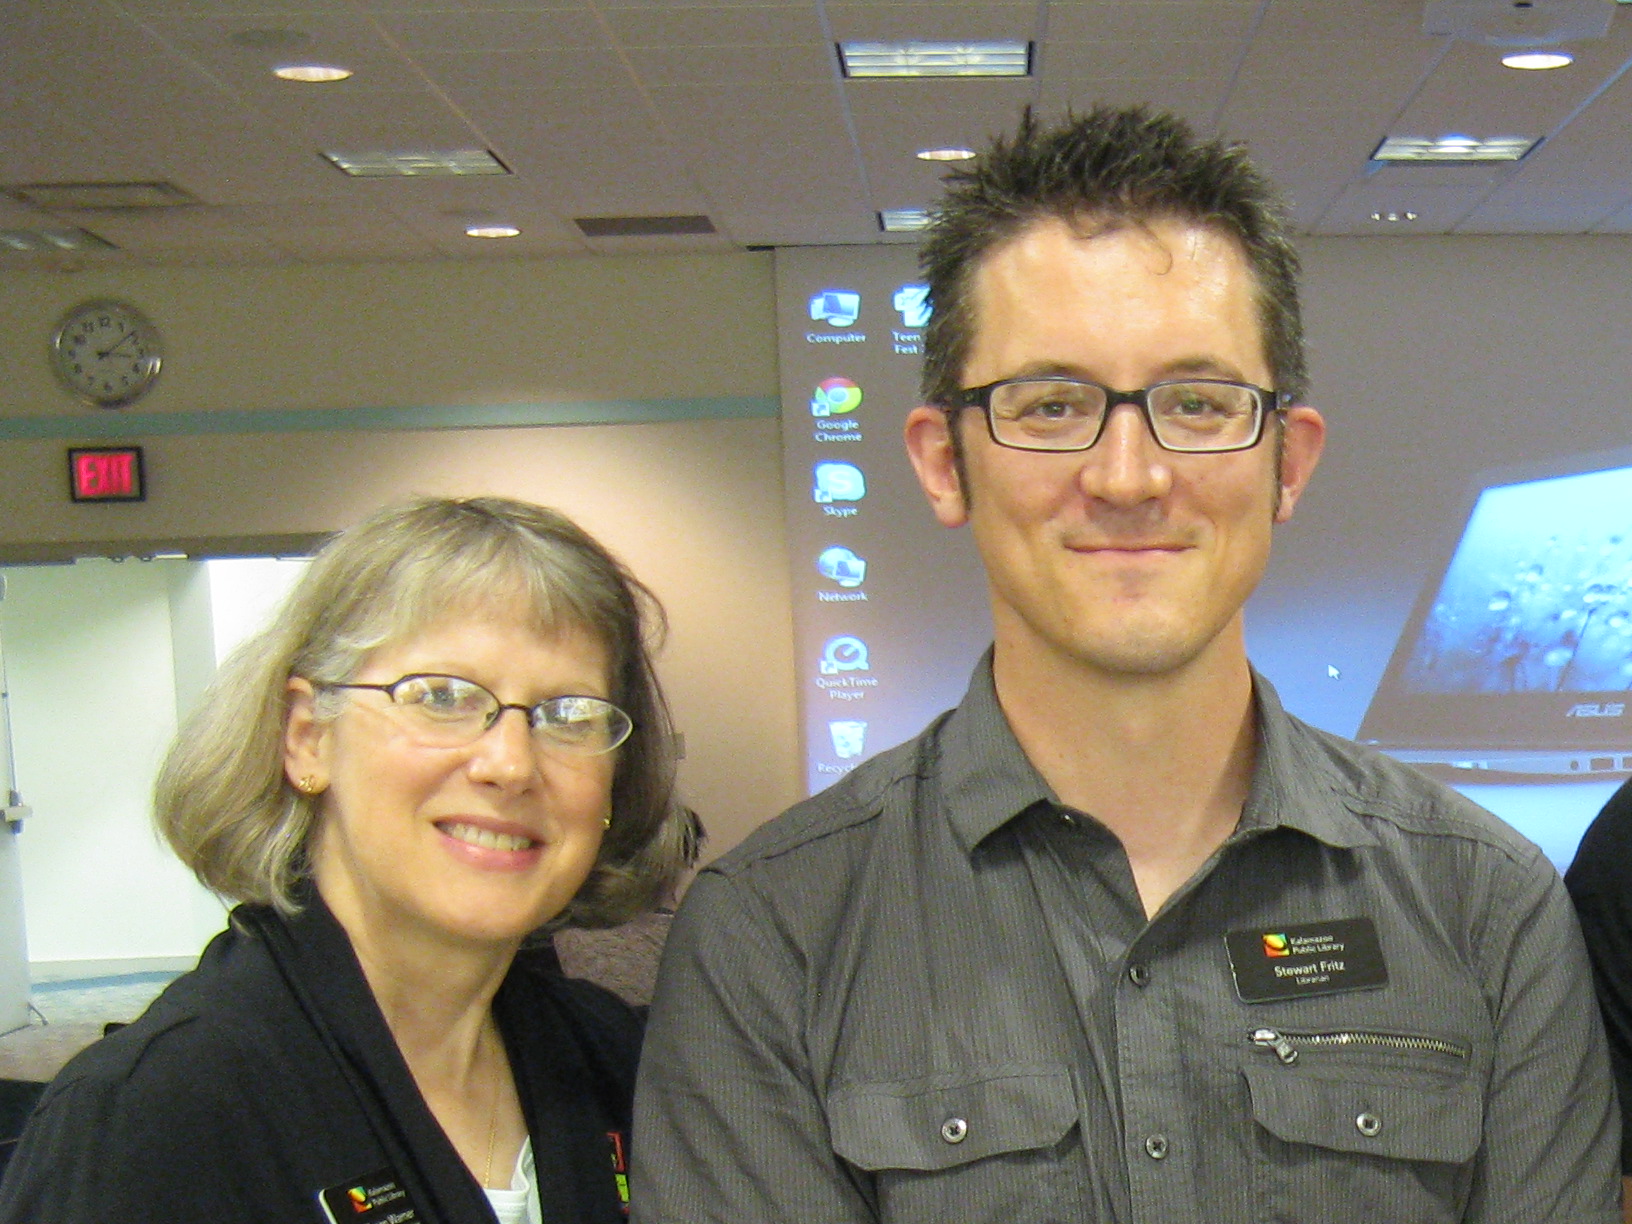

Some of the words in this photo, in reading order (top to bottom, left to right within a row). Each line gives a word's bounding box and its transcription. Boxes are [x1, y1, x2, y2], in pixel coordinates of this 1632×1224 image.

[806, 332, 866, 344] Computer
[816, 420, 859, 431] Google
[814, 431, 862, 442] Chrome
[77, 453, 134, 495] EXIT
[823, 505, 858, 518] Skype
[818, 591, 868, 602] Network
[815, 677, 879, 689] QuickTime
[829, 690, 864, 702] Player
[1566, 702, 1626, 718] ASUS
[1274, 963, 1318, 978] Stewart
[1320, 960, 1346, 973] Fritz
